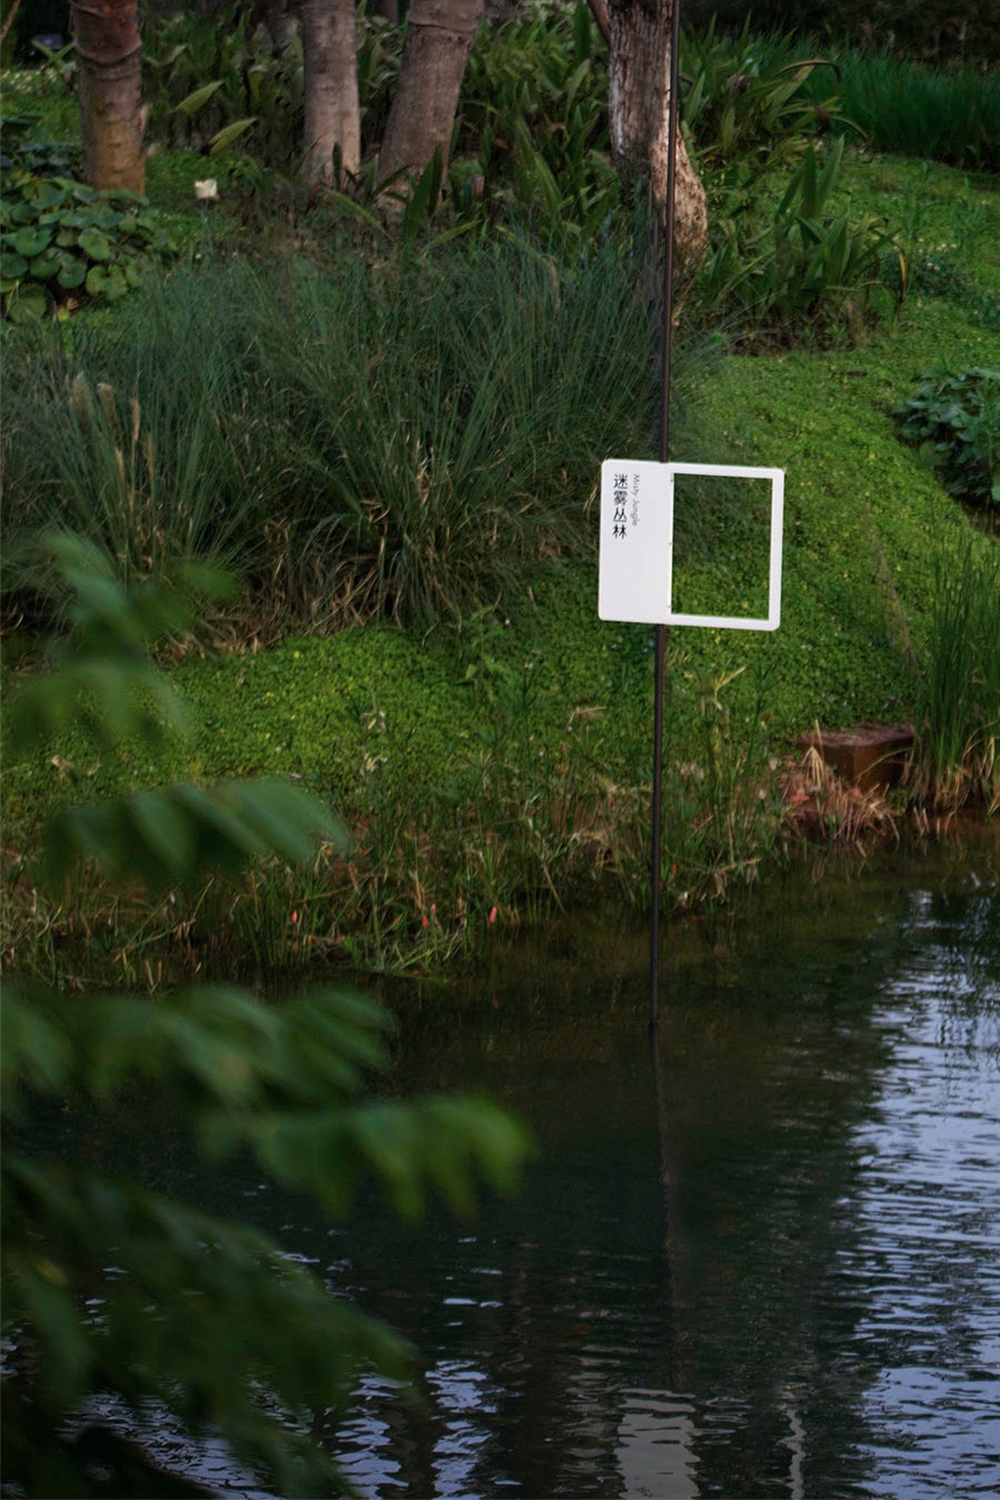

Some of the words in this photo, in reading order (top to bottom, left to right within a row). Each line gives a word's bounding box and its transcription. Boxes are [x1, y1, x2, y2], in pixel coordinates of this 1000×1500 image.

[631, 474, 640, 497] Misty
[612, 473, 628, 540] 迷雾丛林
[630, 500, 640, 526] Jungle
